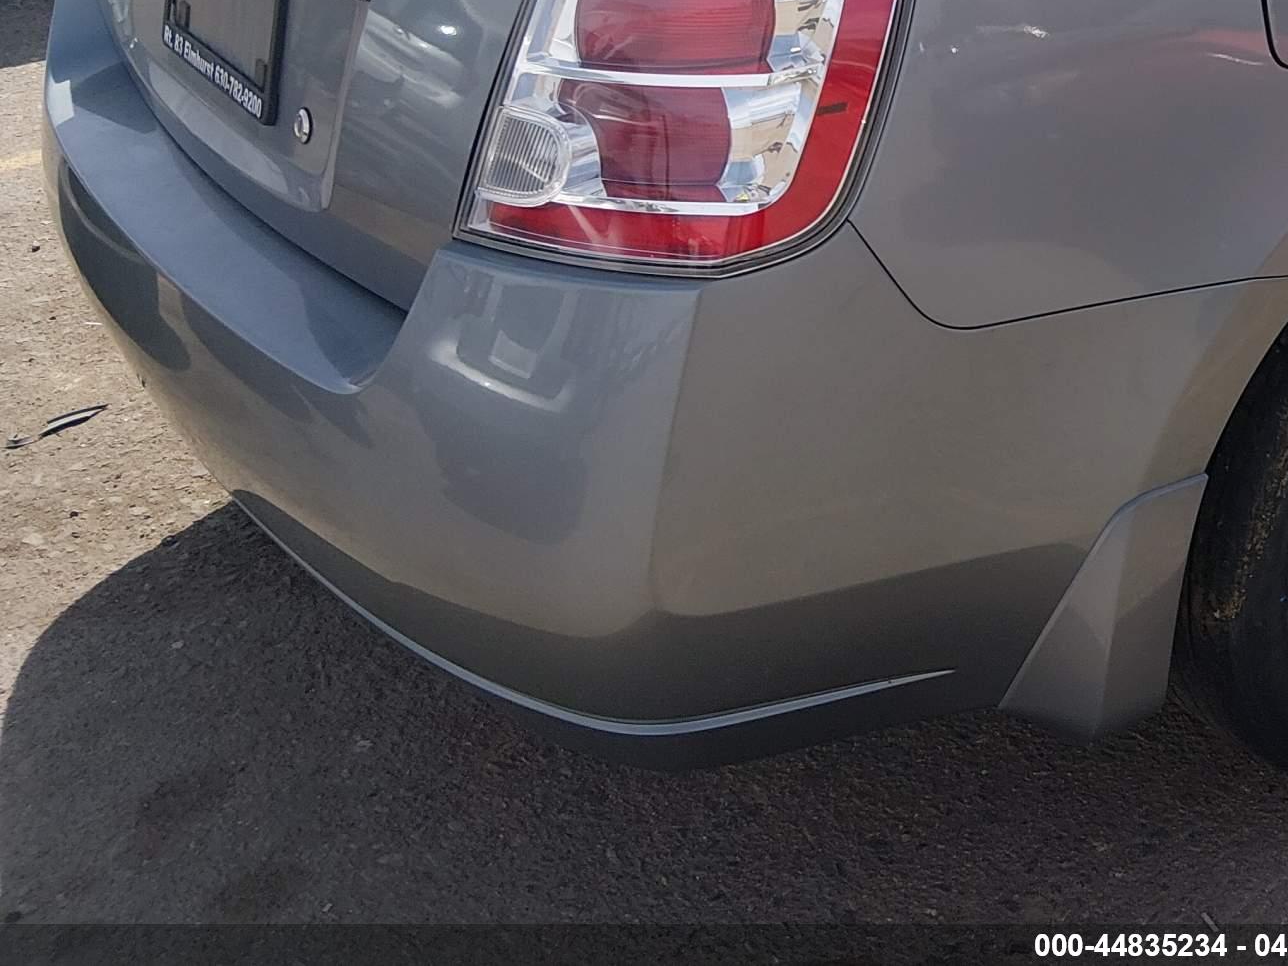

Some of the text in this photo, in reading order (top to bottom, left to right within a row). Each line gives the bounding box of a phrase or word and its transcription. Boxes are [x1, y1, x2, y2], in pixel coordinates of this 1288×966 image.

[163, 25, 262, 119] Rt. 83 Elmhurst 630-782-9200
